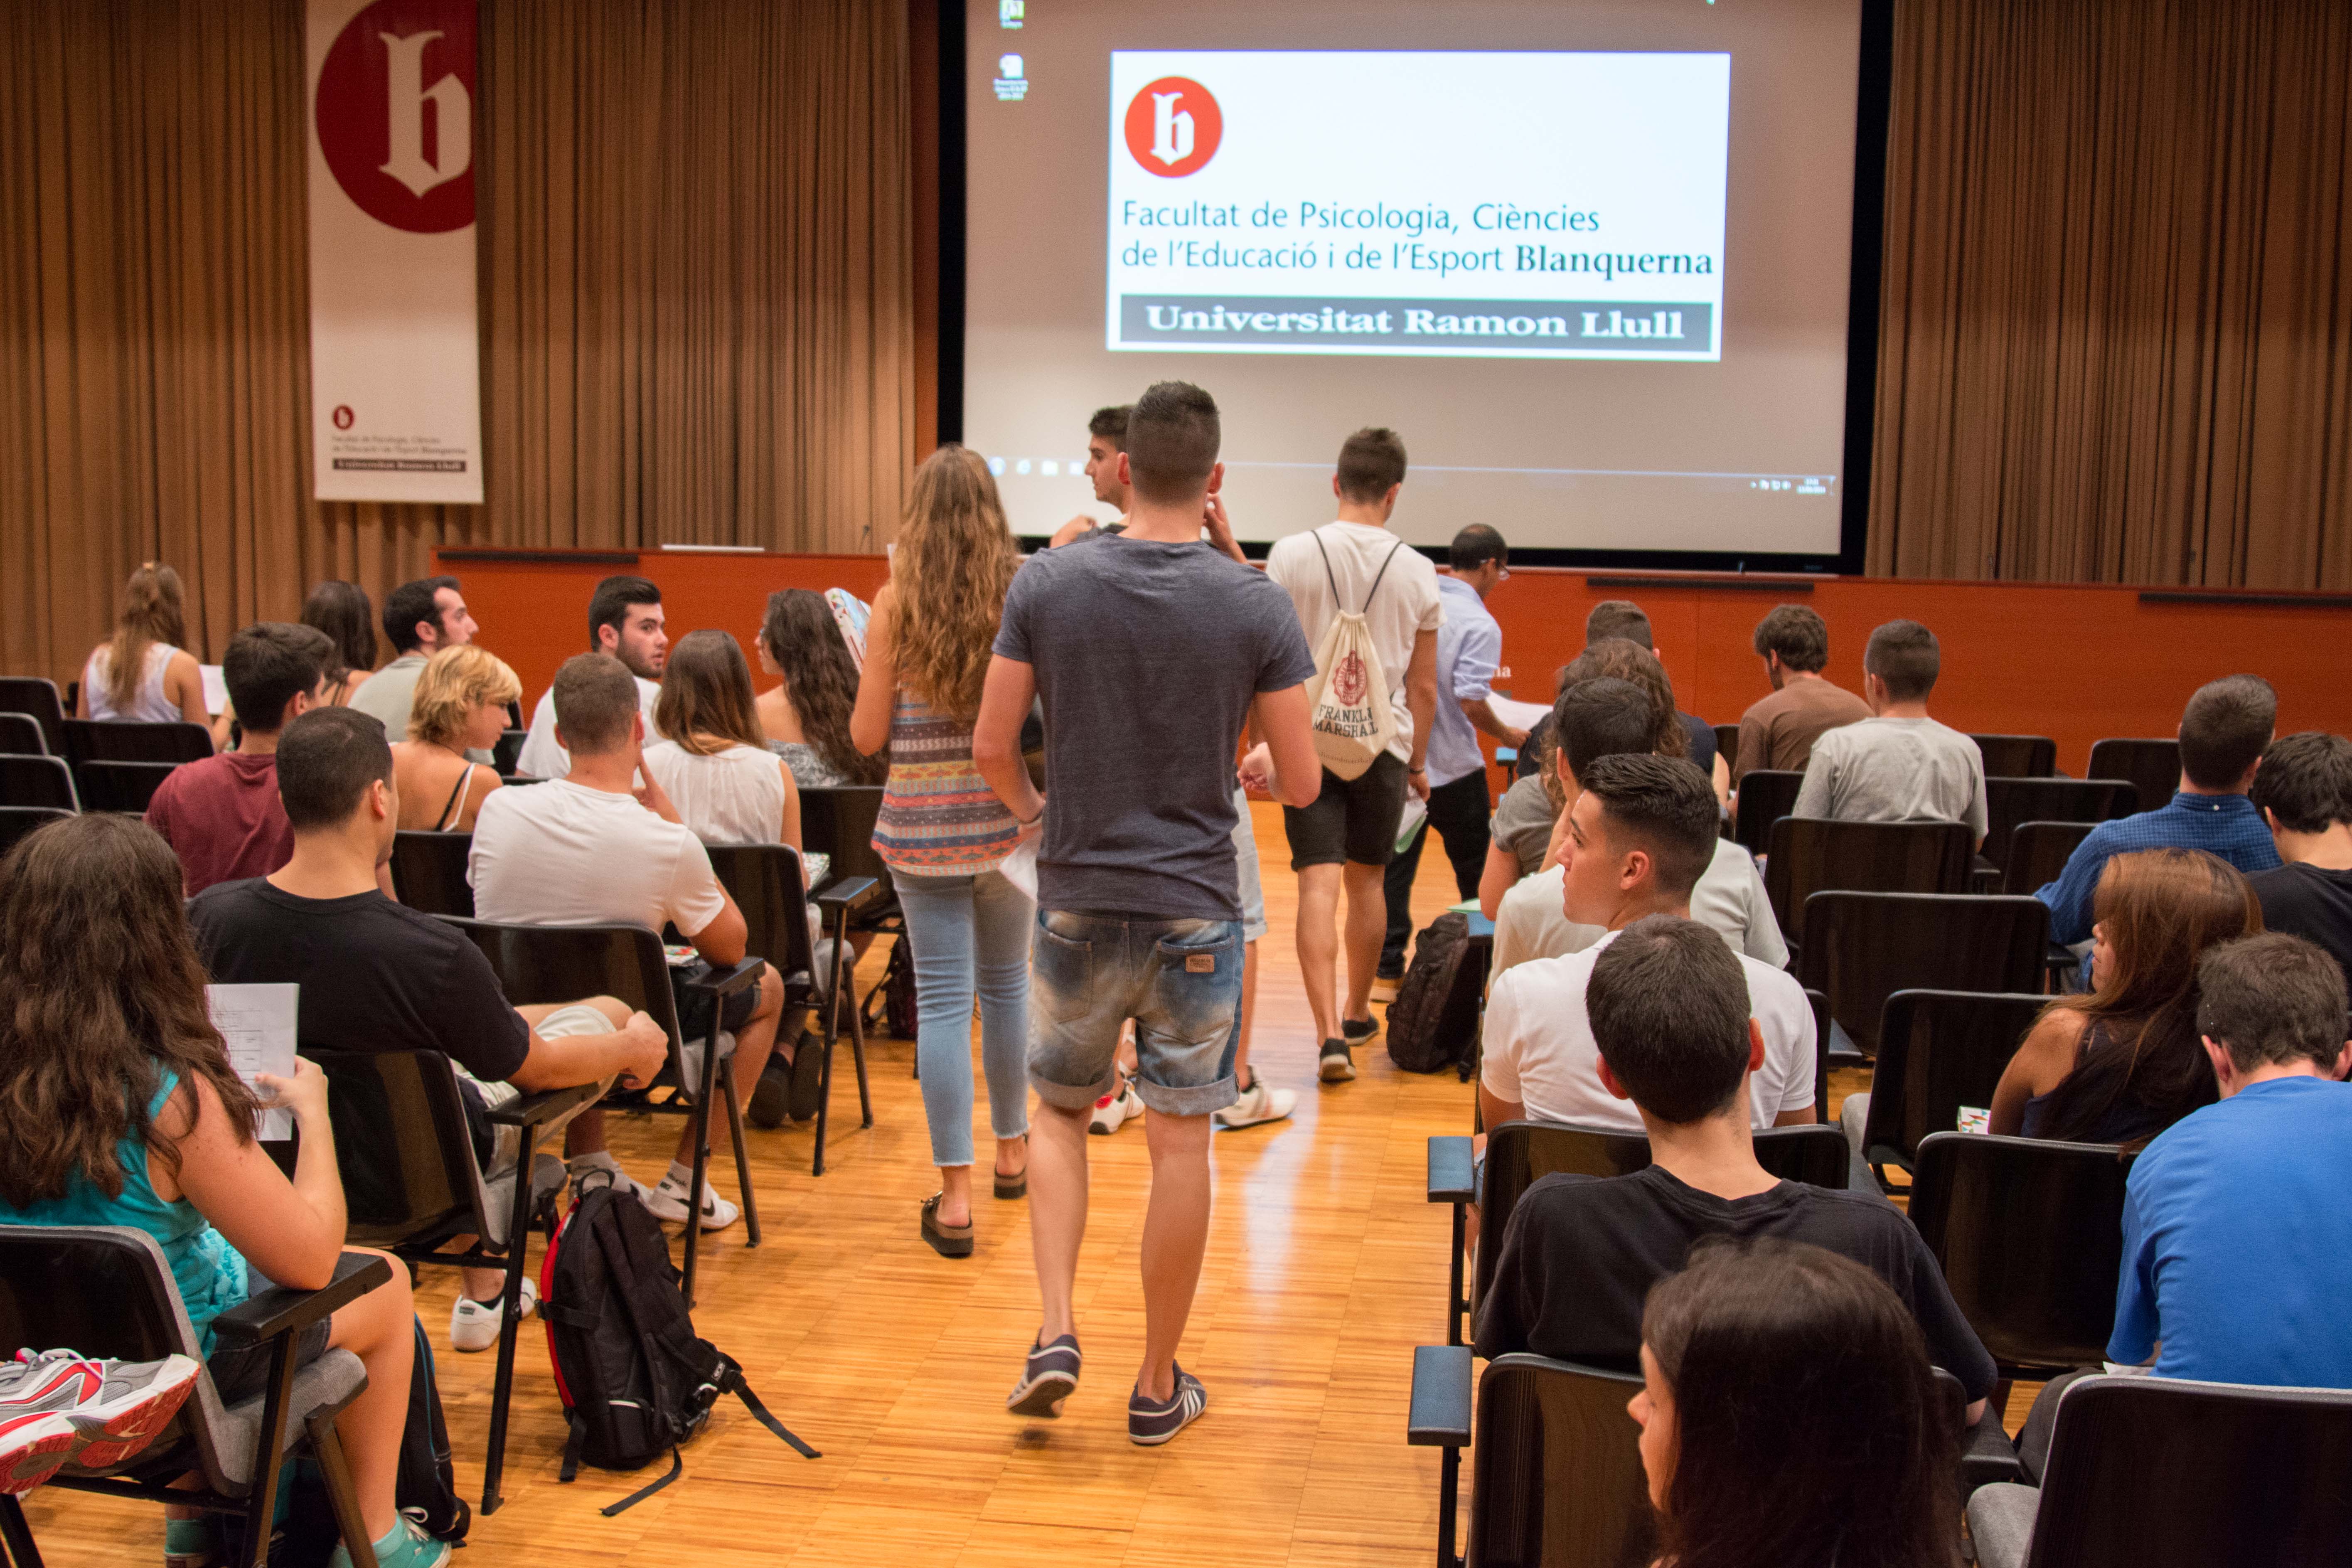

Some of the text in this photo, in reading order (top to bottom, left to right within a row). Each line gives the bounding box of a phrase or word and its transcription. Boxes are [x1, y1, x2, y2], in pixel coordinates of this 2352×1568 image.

[1123, 200, 1600, 237] Facultat de Psicologia, Ciències
[1122, 240, 1713, 281] de l'Educació i de l'Esport Blanquerna
[1145, 305, 1685, 339] Universitat Ramon Llull
